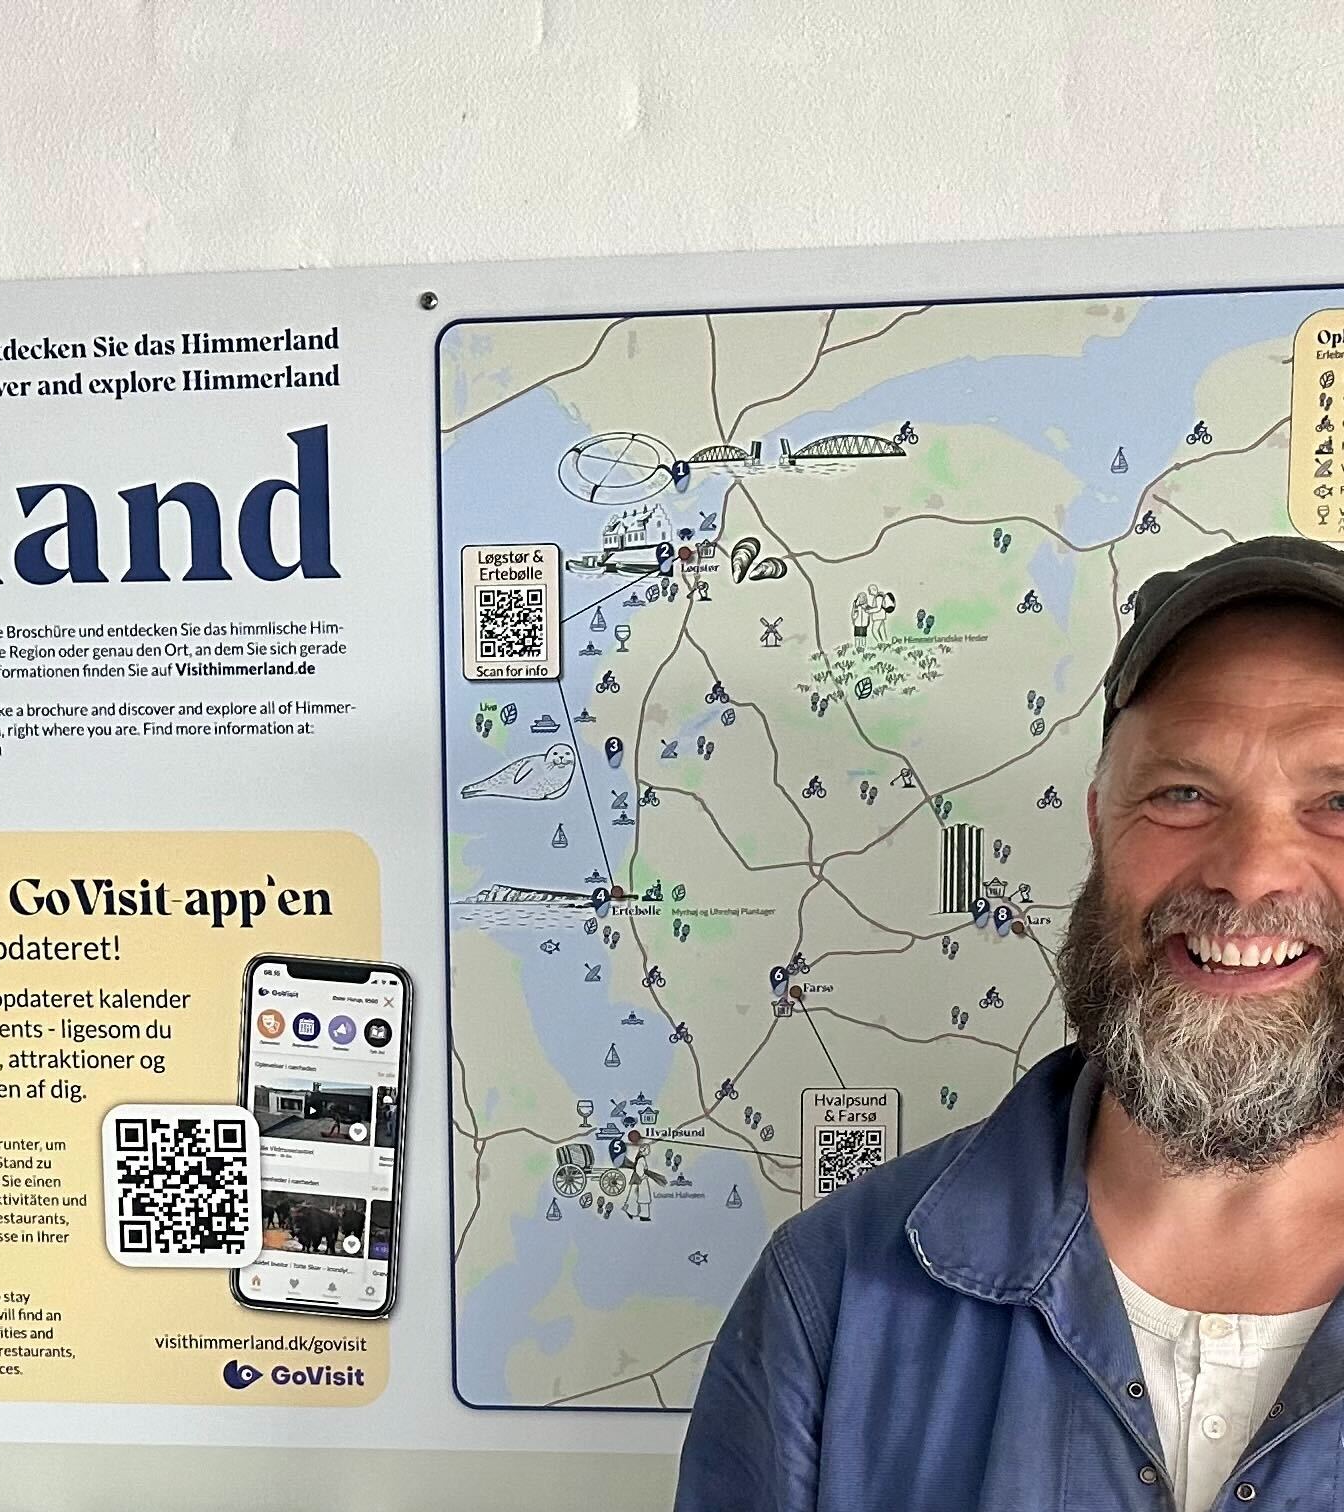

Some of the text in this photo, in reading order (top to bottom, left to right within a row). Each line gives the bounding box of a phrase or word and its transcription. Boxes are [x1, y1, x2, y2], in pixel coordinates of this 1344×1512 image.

[93, 336, 128, 357] Sie
[134, 333, 175, 356] das
[181, 326, 339, 354] Himmerland
[37, 372, 82, 395] and
[88, 370, 176, 400] explore
[182, 363, 340, 391] Himmerland
[677, 463, 686, 476] 1
[478, 549, 544, 566] Løgstør &
[661, 545, 671, 558] 2
[479, 566, 542, 581] Ertebølle
[82, 663, 124, 677] finden
[128, 663, 148, 677] Sie
[151, 662, 172, 676] auf
[175, 660, 315, 676] Visithimmerland.de
[476, 664, 548, 677] Scan for info
[610, 739, 619, 753] 3
[597, 890, 606, 902] 4
[611, 905, 661, 916] Ertebølle
[976, 900, 986, 913] 9
[998, 908, 1008, 921] 8
[775, 969, 784, 981] 6
[99, 988, 191, 1009] kalender
[814, 1093, 886, 1109] Hvalpsund
[824, 1109, 876, 1122] & Farsø
[645, 1126, 704, 1138] Hvalpsund
[613, 1140, 623, 1153] 5
[154, 1333, 367, 1354] visithimmerland.dk/govisit
[271, 1365, 364, 1386] GoVisit
